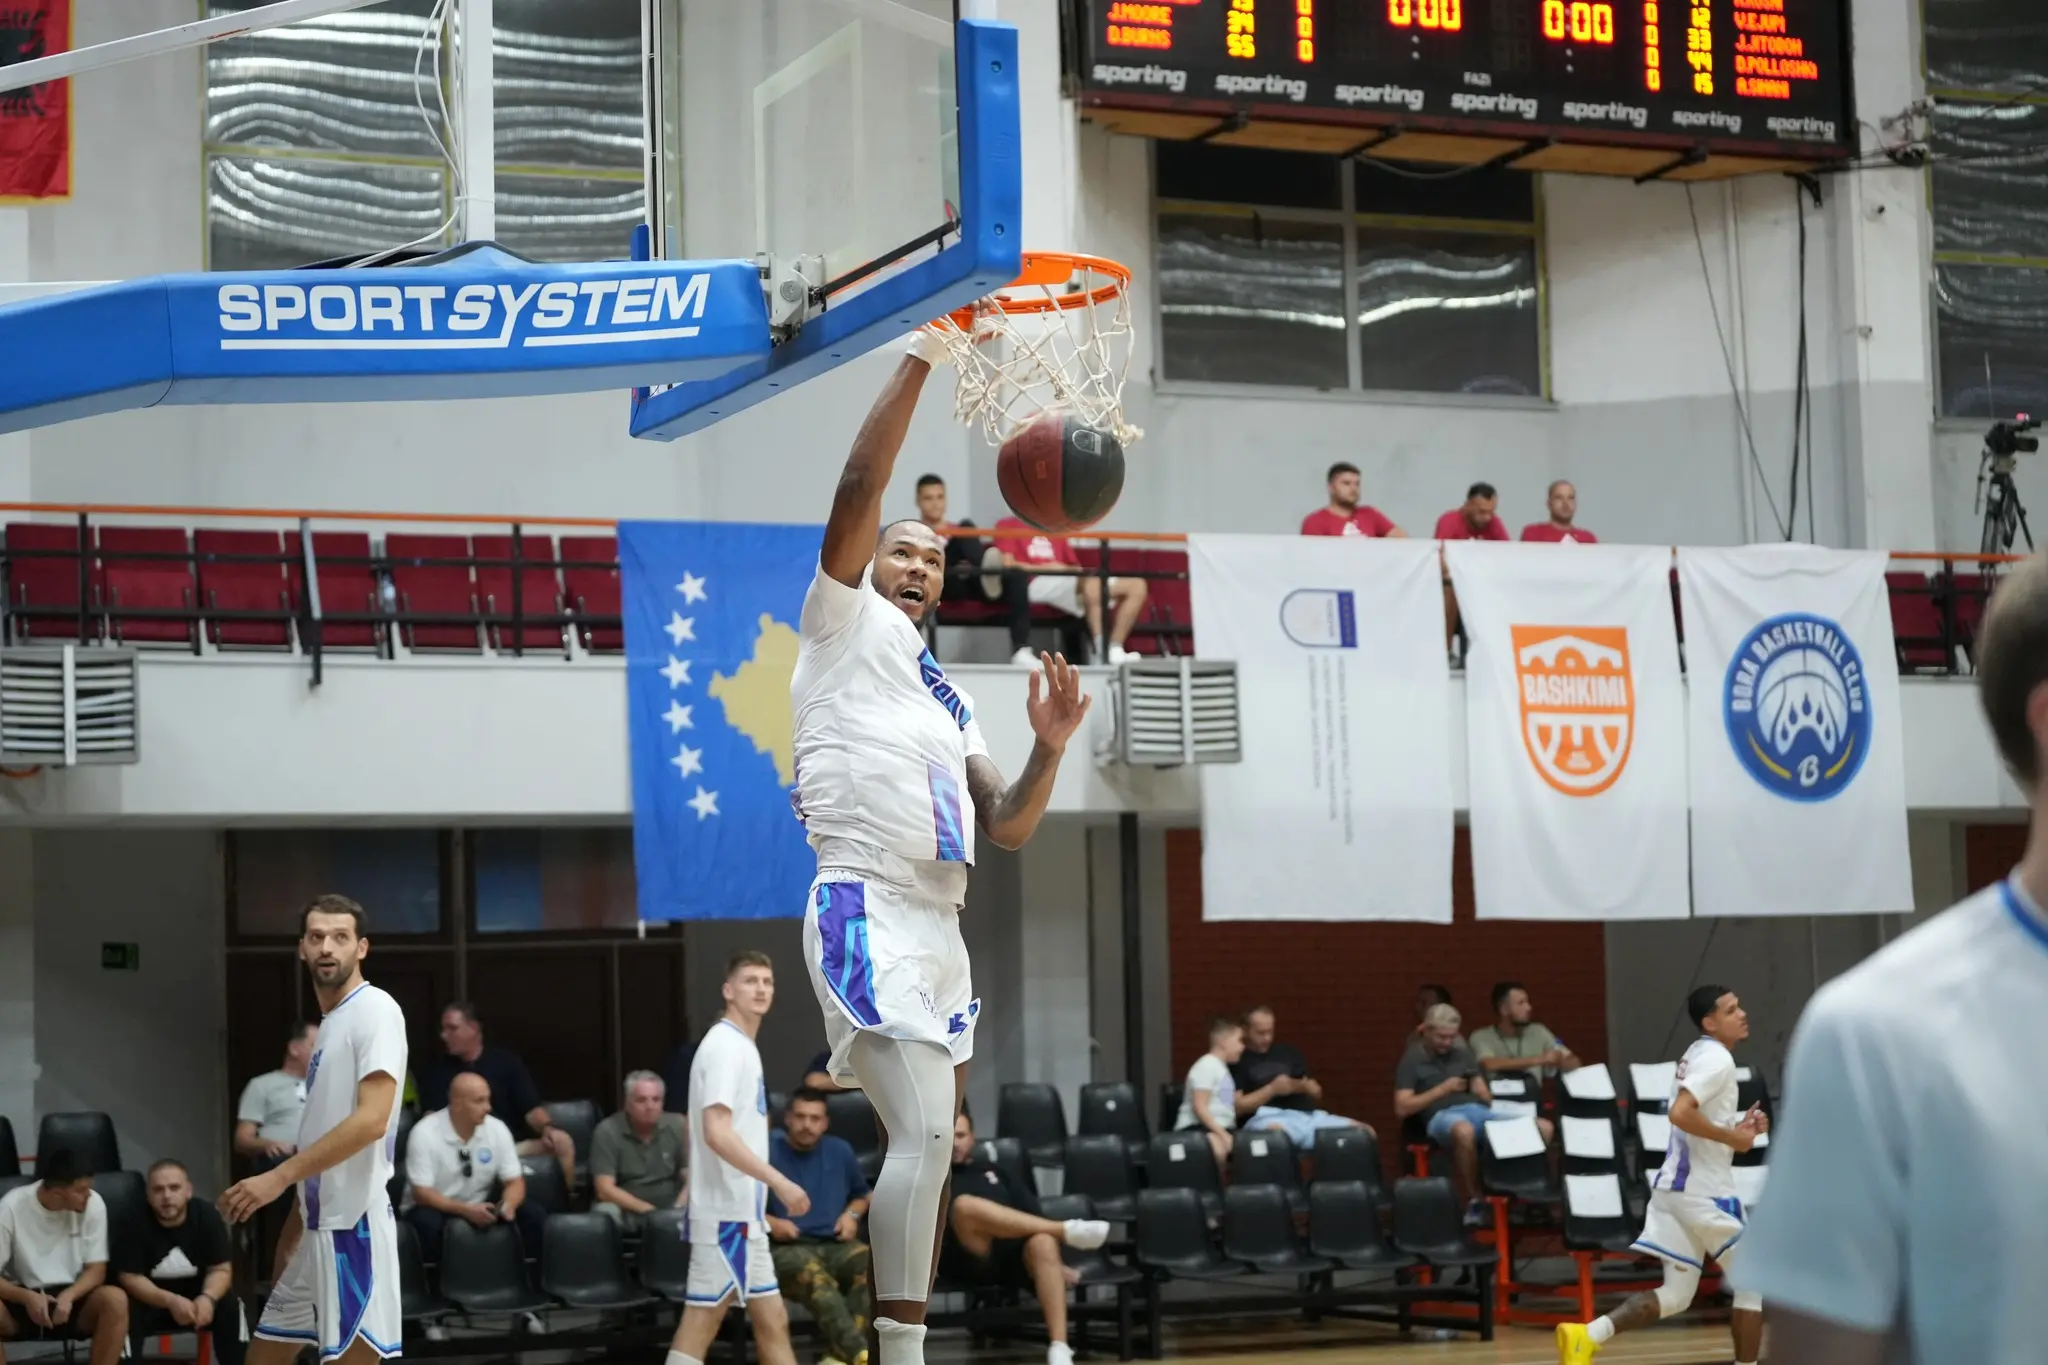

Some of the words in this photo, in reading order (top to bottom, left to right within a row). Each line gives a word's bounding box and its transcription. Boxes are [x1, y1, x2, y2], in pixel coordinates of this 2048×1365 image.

[1543, 0, 1614, 43] 0:00
[1645, 3, 1658, 24] 0
[1297, 16, 1312, 38] 0
[1646, 25, 1659, 46] 0
[1687, 27, 1712, 50] 33
[1227, 33, 1256, 57] 55
[1297, 39, 1314, 62] 0
[1647, 47, 1660, 68] 0
[1687, 51, 1712, 72] 44
[1093, 64, 1187, 92] sporting
[1215, 74, 1308, 101] sporting
[1648, 69, 1661, 91] 0
[1694, 72, 1714, 95] 15
[1335, 84, 1424, 111] sporting
[1451, 93, 1538, 119] sporting
[1563, 102, 1648, 128] sporting
[1672, 110, 1742, 134] sporting
[1766, 116, 1836, 141] sporting
[1751, 621, 1846, 665] BASKETBALL
[1842, 660, 1864, 713] CLUB
[1523, 674, 1628, 708] BASHKIMI
